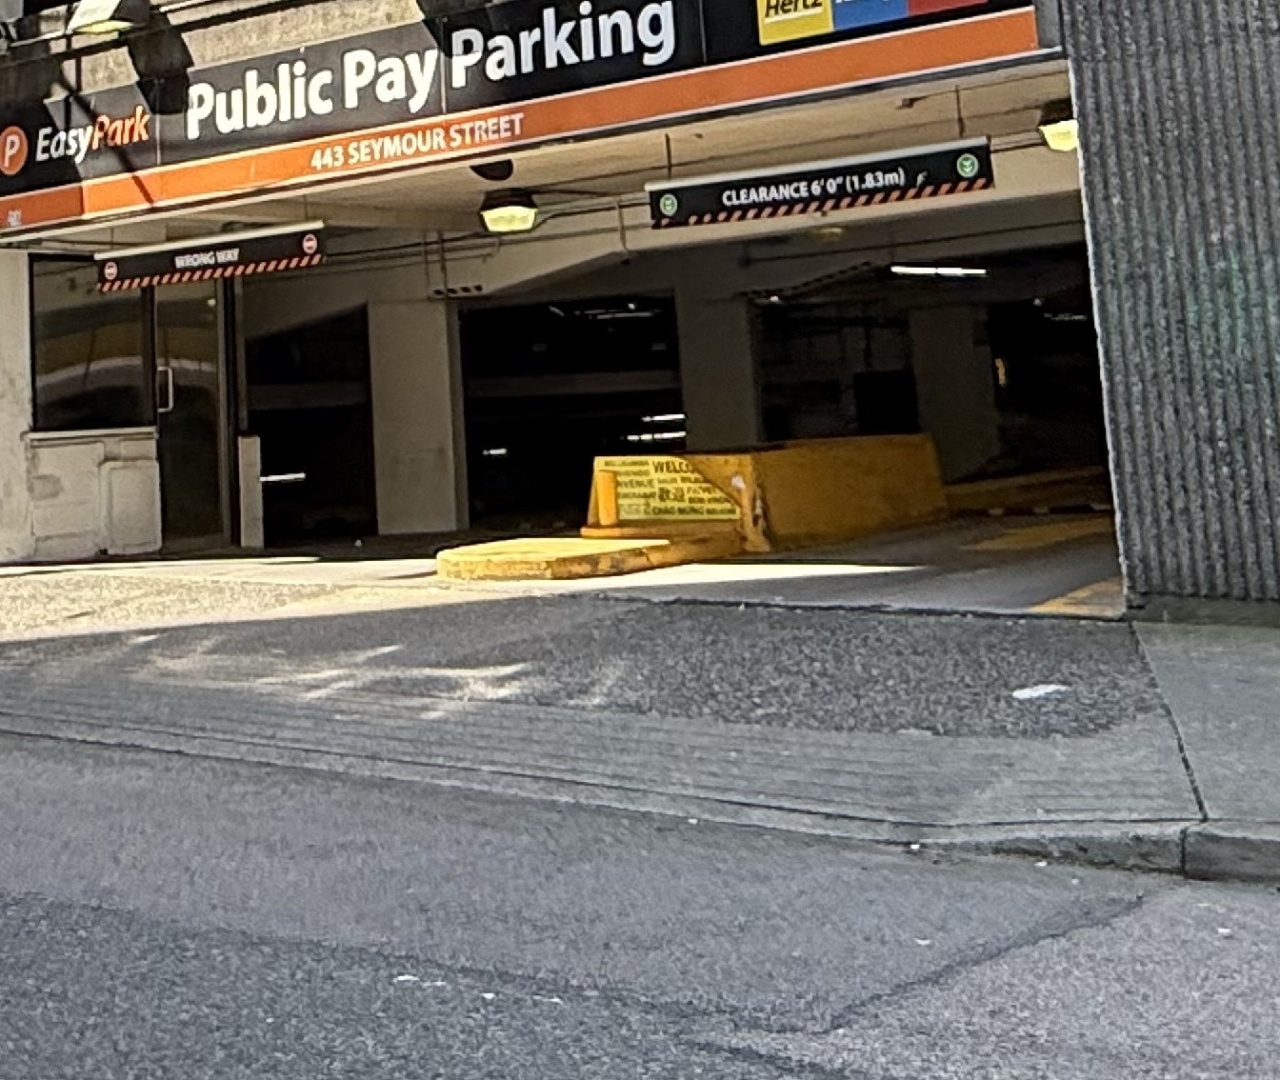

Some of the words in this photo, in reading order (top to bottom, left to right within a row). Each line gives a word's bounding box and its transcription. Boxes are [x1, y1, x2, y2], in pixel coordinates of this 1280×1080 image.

[185, 60, 333, 141] Public
[342, 48, 440, 115] Pay
[451, 0, 677, 89] Parking
[35, 104, 151, 165] EasyPark
[310, 145, 345, 171] 443
[347, 127, 446, 165] SEYMOUR
[449, 112, 525, 149] STREET
[722, 182, 810, 207] CLEARANCE
[846, 167, 906, 193] (1.83m)
[174, 250, 215, 269] WRONG
[216, 247, 240, 264] WAY
